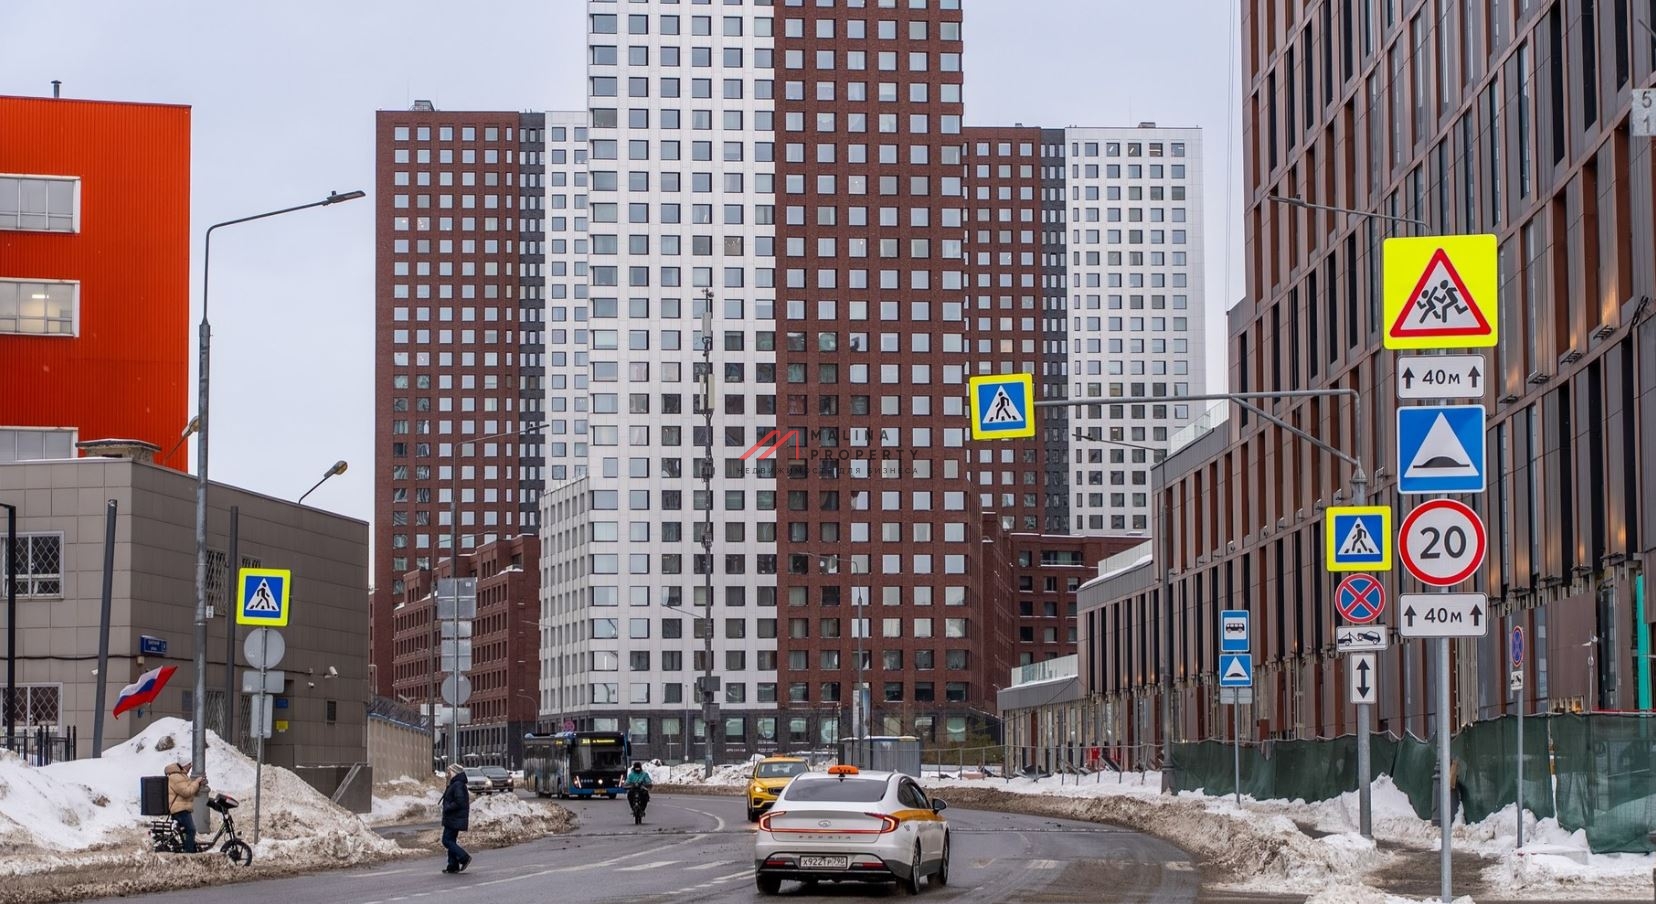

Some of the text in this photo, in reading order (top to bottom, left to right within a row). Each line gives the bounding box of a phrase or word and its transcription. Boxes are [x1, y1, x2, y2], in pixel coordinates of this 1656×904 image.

[1642, 90, 1652, 108] 5
[1422, 369, 1460, 384] 40м
[1420, 525, 1467, 559] 20
[1424, 607, 1462, 623] 40м
